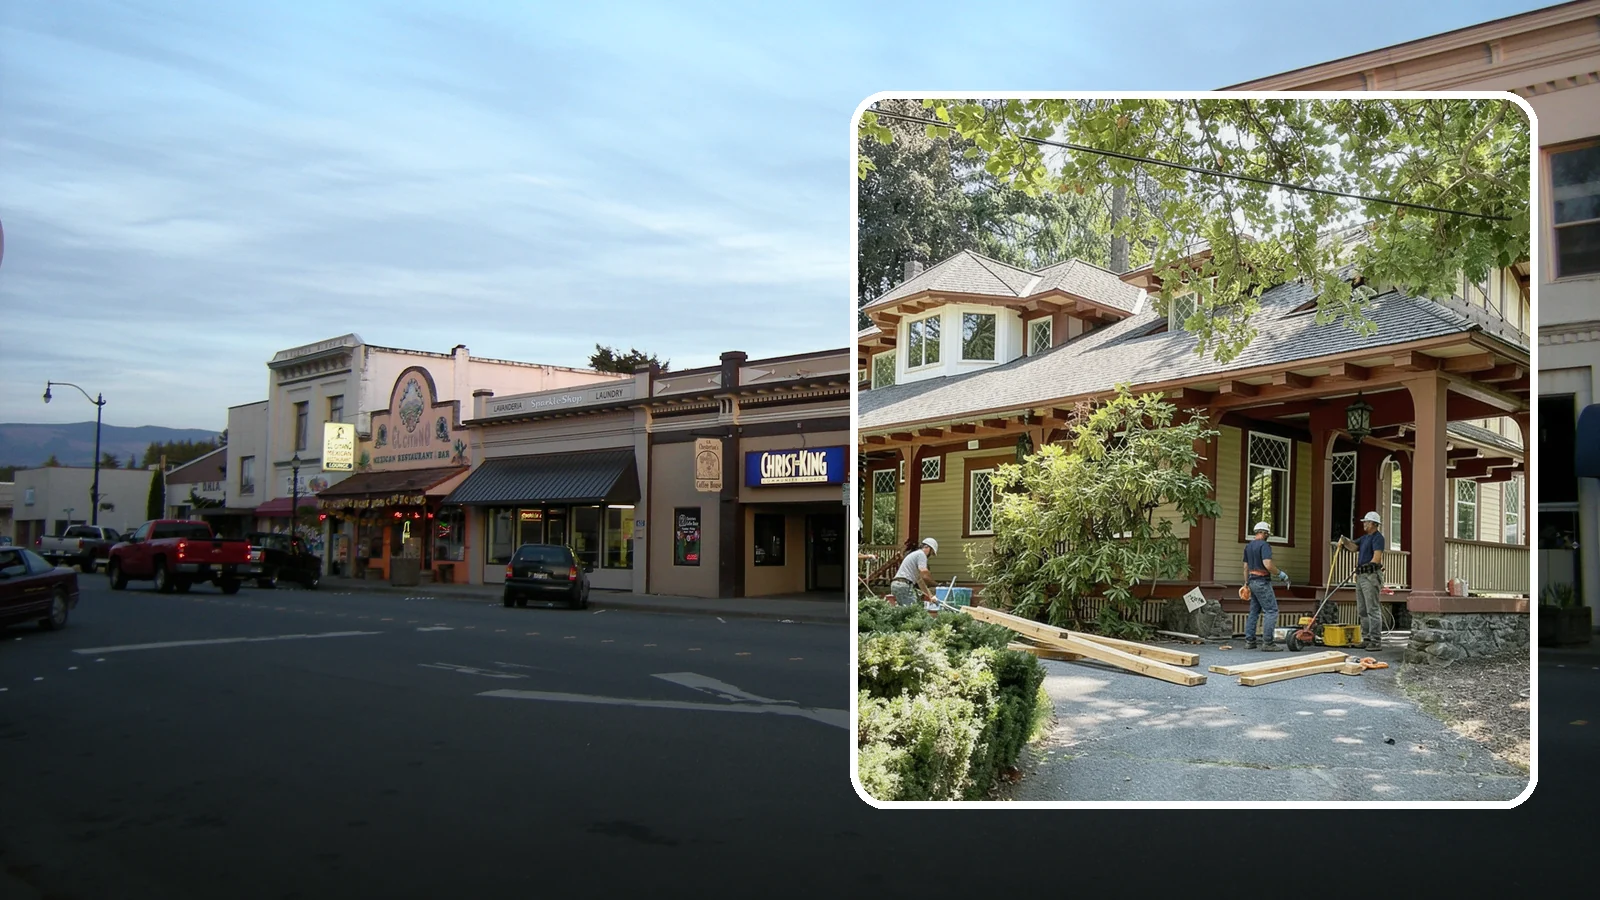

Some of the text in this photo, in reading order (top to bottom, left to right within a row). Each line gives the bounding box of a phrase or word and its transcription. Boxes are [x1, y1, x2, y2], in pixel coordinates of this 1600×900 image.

[595, 388, 623, 400] LAUNDRY
[493, 402, 523, 412] LAVANDERIA
[530, 394, 583, 409] Sparkle Shop
[374, 450, 450, 464] MEXICAN RESTAURANT BAR
[761, 450, 827, 478] CHRIST KING
